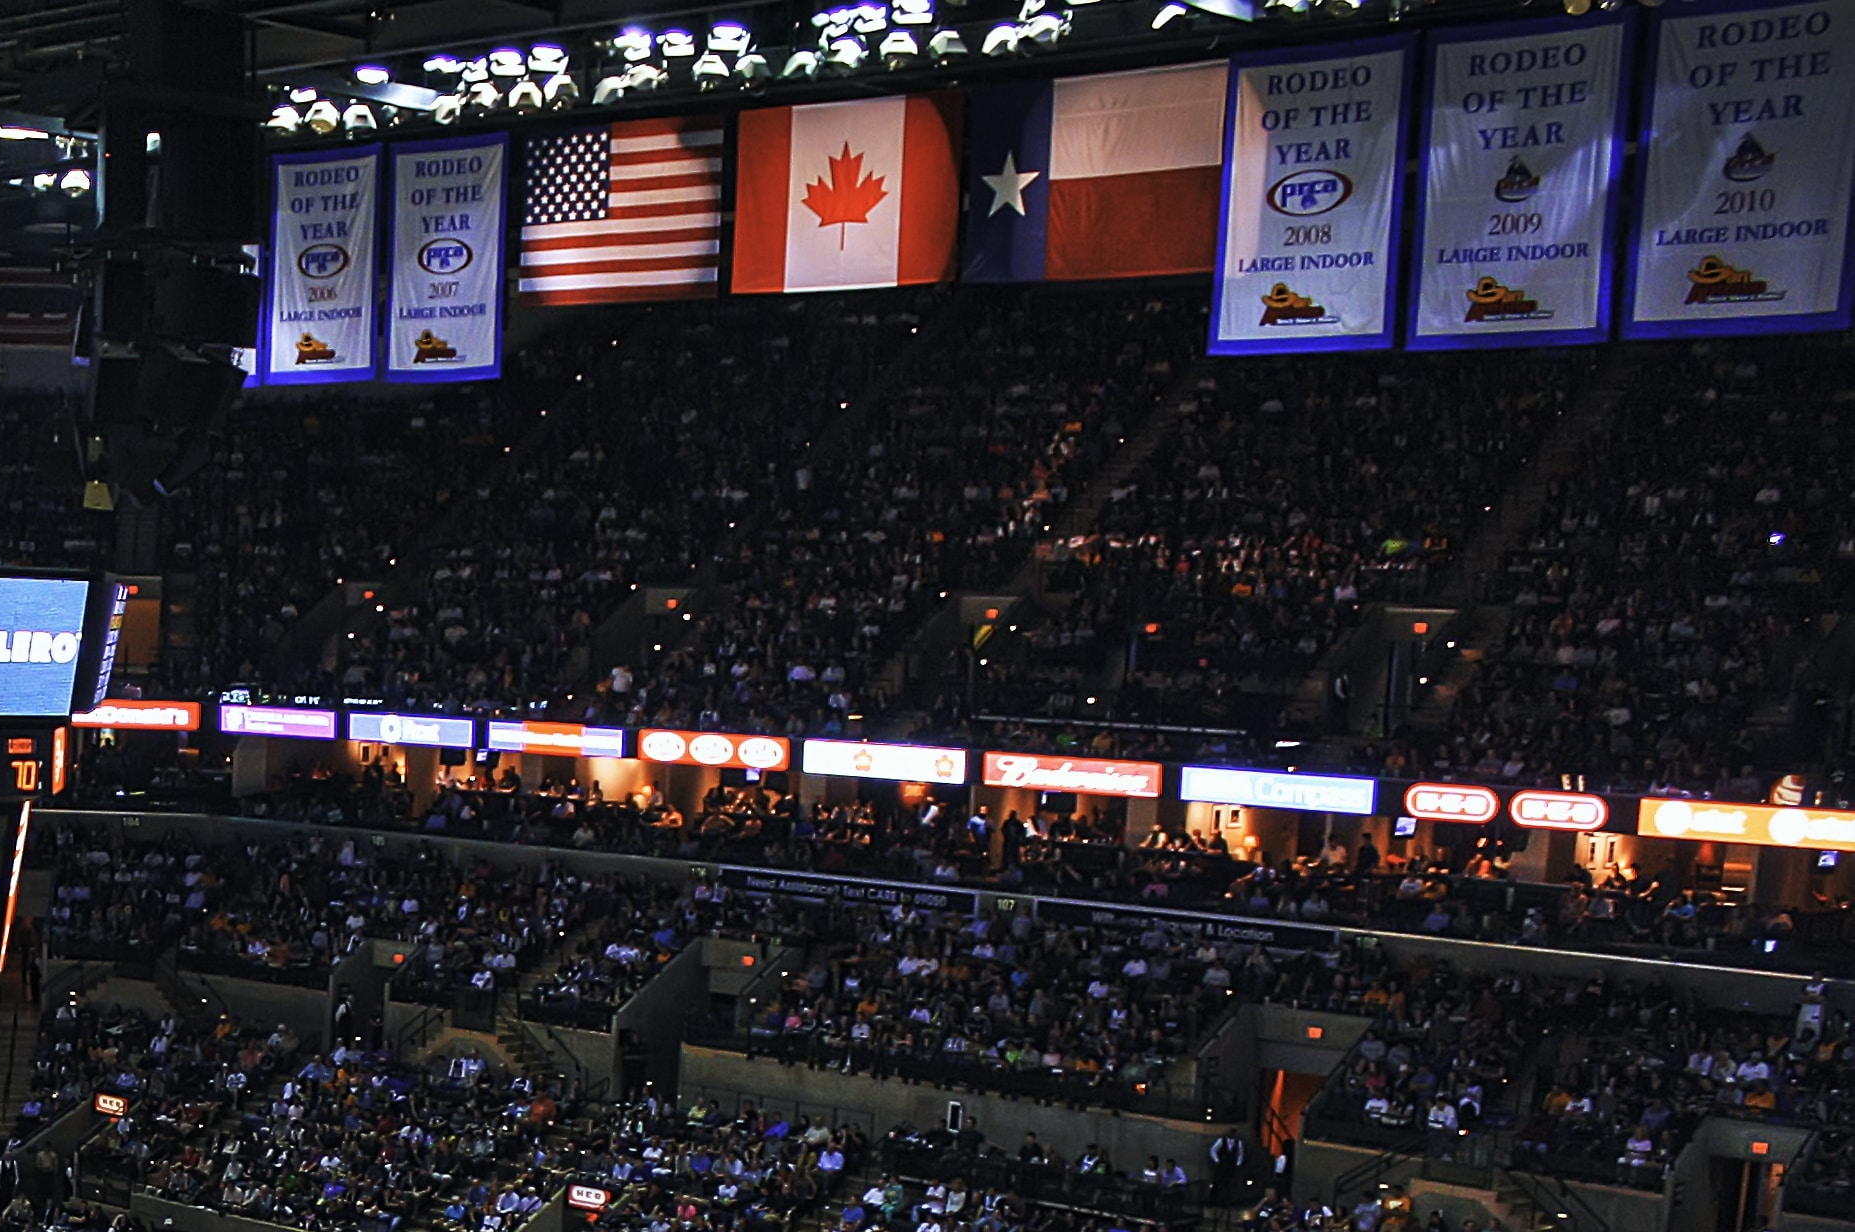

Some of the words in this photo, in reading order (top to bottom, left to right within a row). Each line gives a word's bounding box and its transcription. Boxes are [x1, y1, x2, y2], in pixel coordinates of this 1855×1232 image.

[1696, 10, 1832, 50] RODEO
[1468, 42, 1587, 77] RODEO
[1689, 63, 1738, 89] OF
[1749, 51, 1832, 84] THE
[1267, 64, 1372, 96] RODEO
[1462, 89, 1506, 115] OF
[1517, 80, 1588, 110] THE
[1708, 93, 1805, 126] YEAR
[1261, 107, 1299, 132] OF
[1309, 100, 1373, 127] THE
[1478, 121, 1566, 151] YEAR
[1275, 138, 1352, 166] YEAR
[294, 165, 360, 187] RODEO
[414, 156, 483, 178] RODEO
[290, 197, 315, 215] OF
[322, 193, 360, 211] THE
[410, 188, 437, 207] OF
[442, 183, 483, 204] THE
[1714, 188, 1776, 216] 2010
[300, 221, 348, 241] YEAR
[420, 213, 471, 234] YEAR
[1283, 225, 1332, 247] 2008
[1488, 212, 1542, 236] 2009
[1655, 227, 1729, 247] LARGE
[1734, 218, 1830, 242] INDOOR
[1239, 254, 1294, 273] LARGE
[1300, 251, 1375, 270] INDOOR
[1437, 245, 1502, 264] LARGE
[1505, 241, 1590, 263] INDOOR
[11, 760, 37, 790] 70
